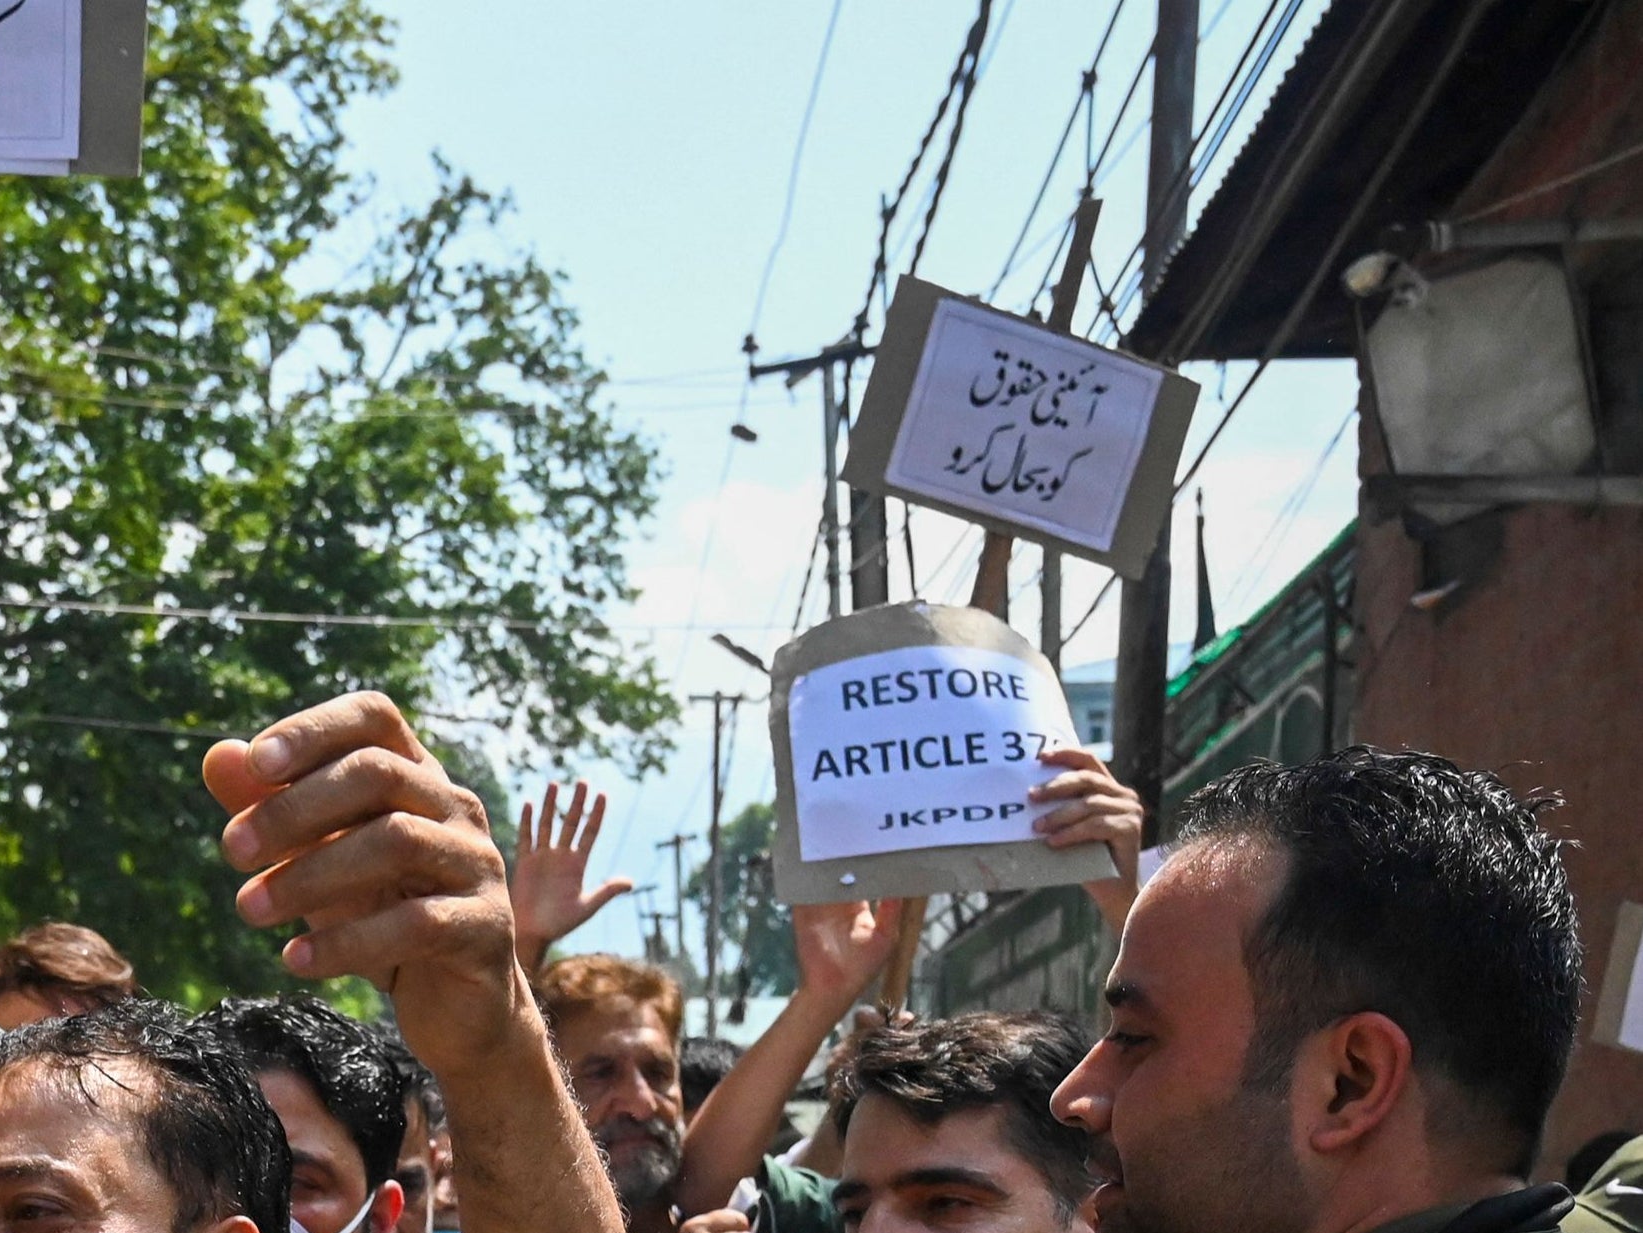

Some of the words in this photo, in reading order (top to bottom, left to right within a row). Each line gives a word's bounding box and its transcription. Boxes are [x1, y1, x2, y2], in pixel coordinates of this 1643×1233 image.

[969, 350, 1050, 408] حقوق
[944, 423, 1015, 475] کرو
[981, 433, 1050, 494] بحال
[1040, 447, 1094, 501] کو
[841, 667, 1029, 712] RESTORE
[811, 732, 989, 782] ARTICLE
[1001, 731, 1058, 762] 37
[877, 803, 1026, 831] JKPDP
